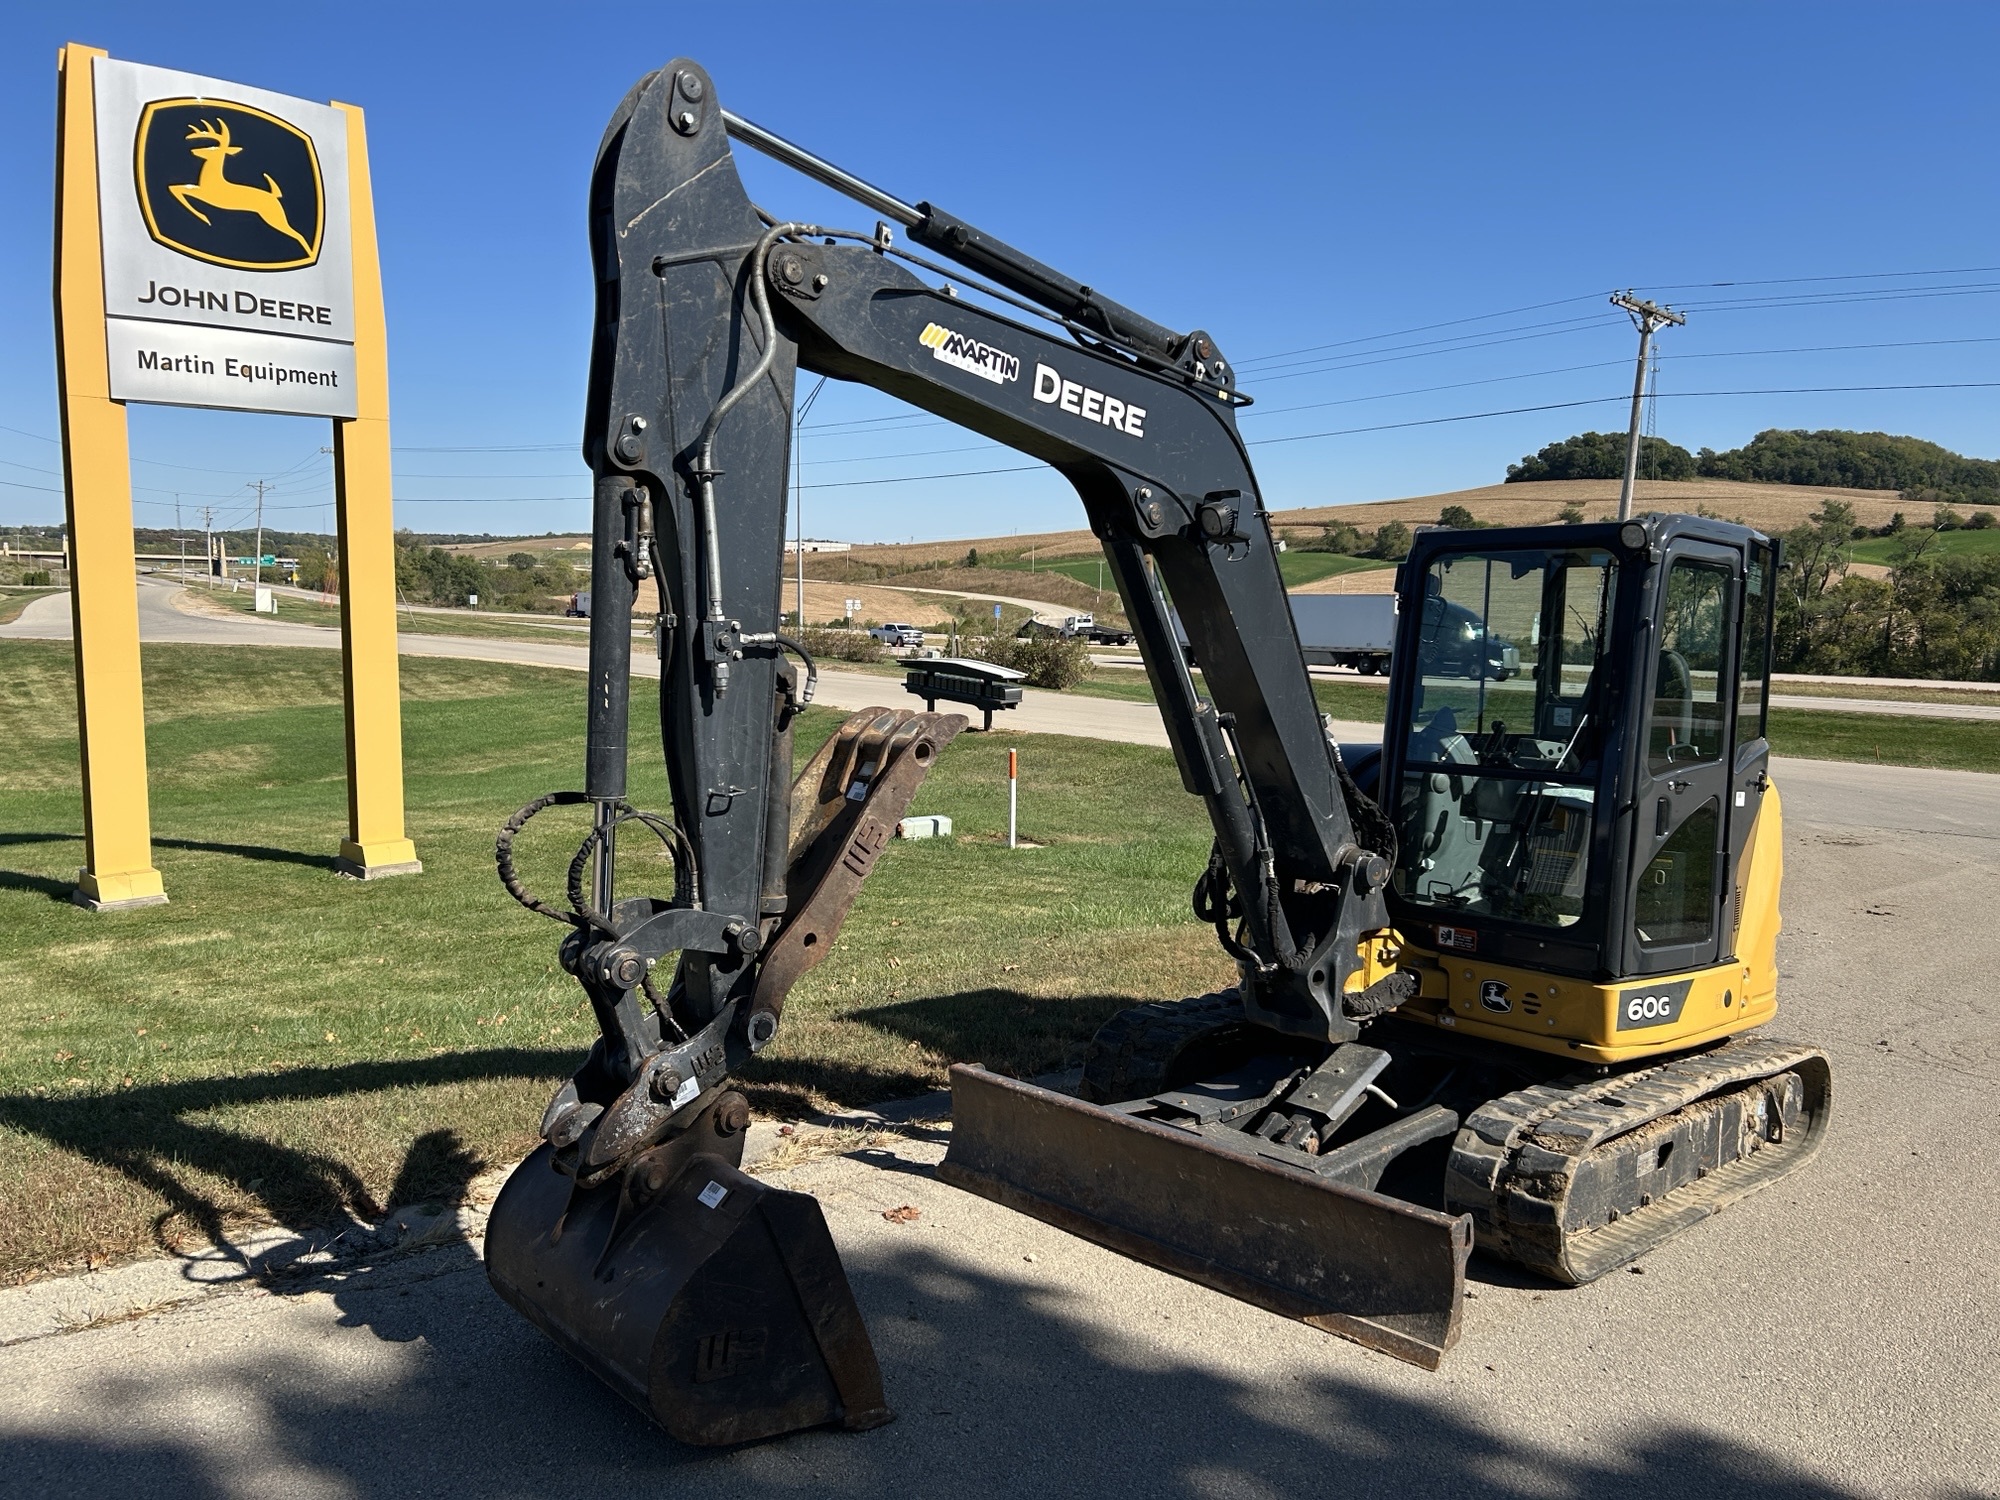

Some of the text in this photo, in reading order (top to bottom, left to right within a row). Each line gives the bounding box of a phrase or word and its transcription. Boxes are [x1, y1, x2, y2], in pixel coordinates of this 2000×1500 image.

[138, 280, 332, 325] JOHN DEERE
[138, 350, 338, 388] Martin Equipment
[942, 333, 1018, 379] MARTIN
[1033, 362, 1147, 438] DEERE
[1627, 996, 1671, 1022] 60G
